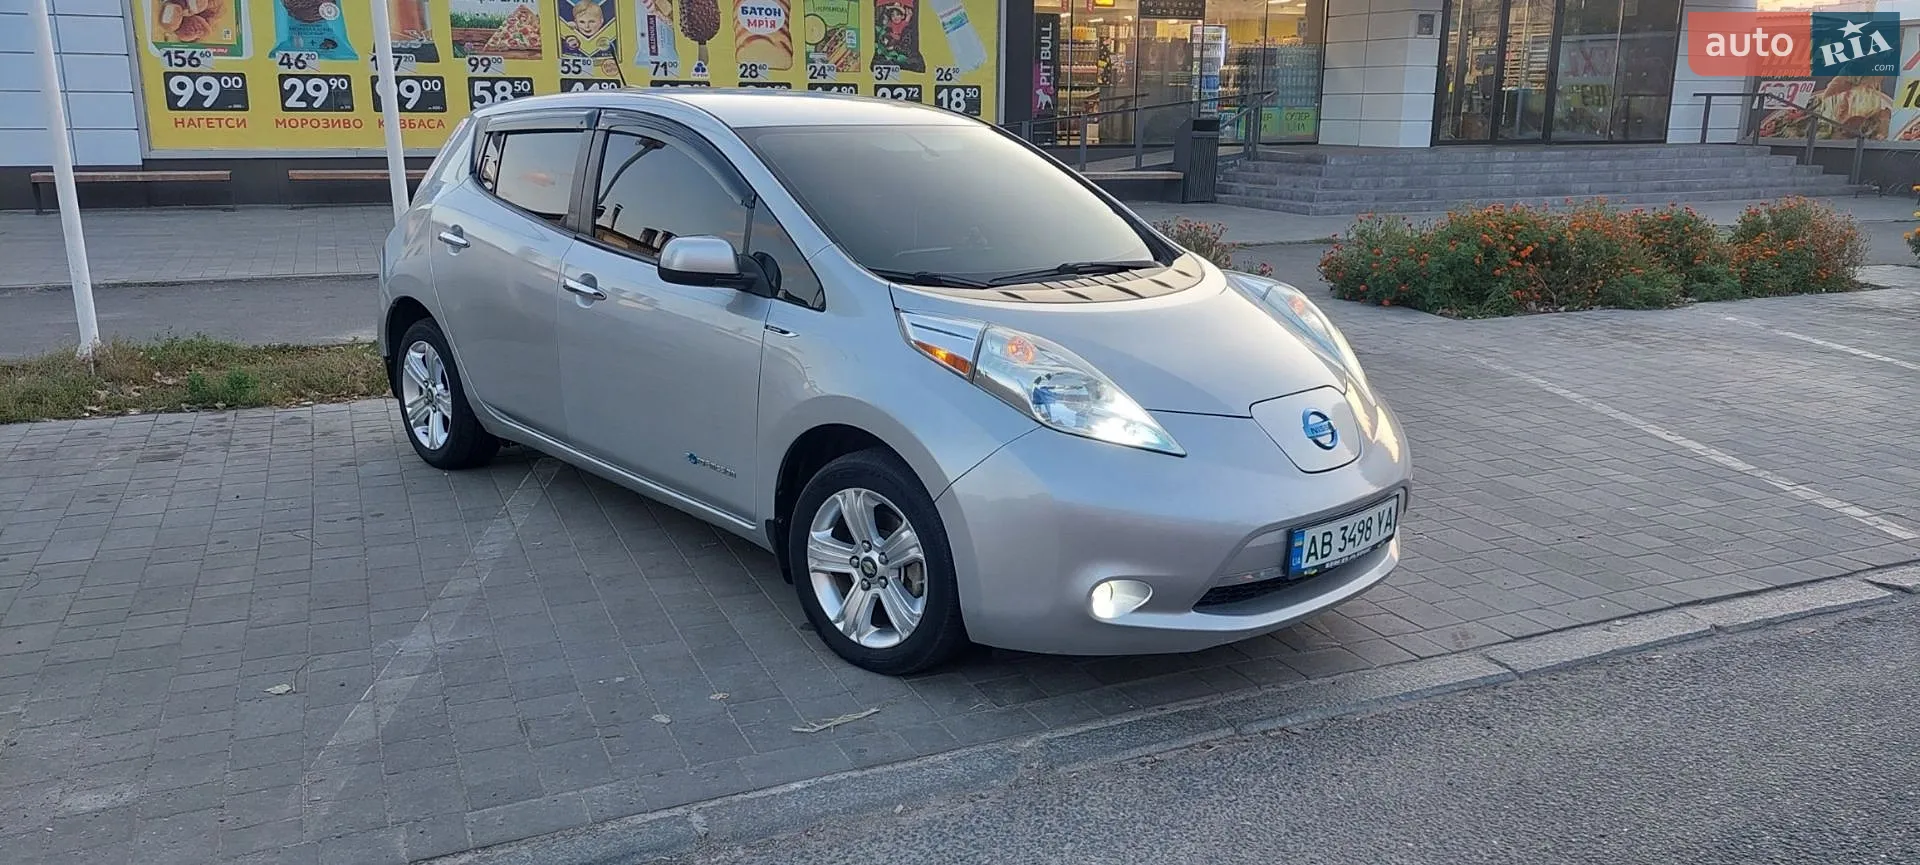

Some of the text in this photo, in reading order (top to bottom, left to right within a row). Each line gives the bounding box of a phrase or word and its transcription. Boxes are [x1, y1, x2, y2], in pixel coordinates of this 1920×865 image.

[741, 6, 781, 16] БАТОН
[747, 17, 776, 28] МРІЯ
[1040, 22, 1052, 60] BULL
[371, 55, 402, 71] 17
[174, 117, 247, 128] НАГЕТСИ
[275, 118, 363, 129] МОРОЗИВО
[378, 118, 445, 129] КВБАСА
[1305, 531, 1332, 563] AB
[1338, 517, 1372, 552] 3498
[1378, 507, 1392, 536] YA
